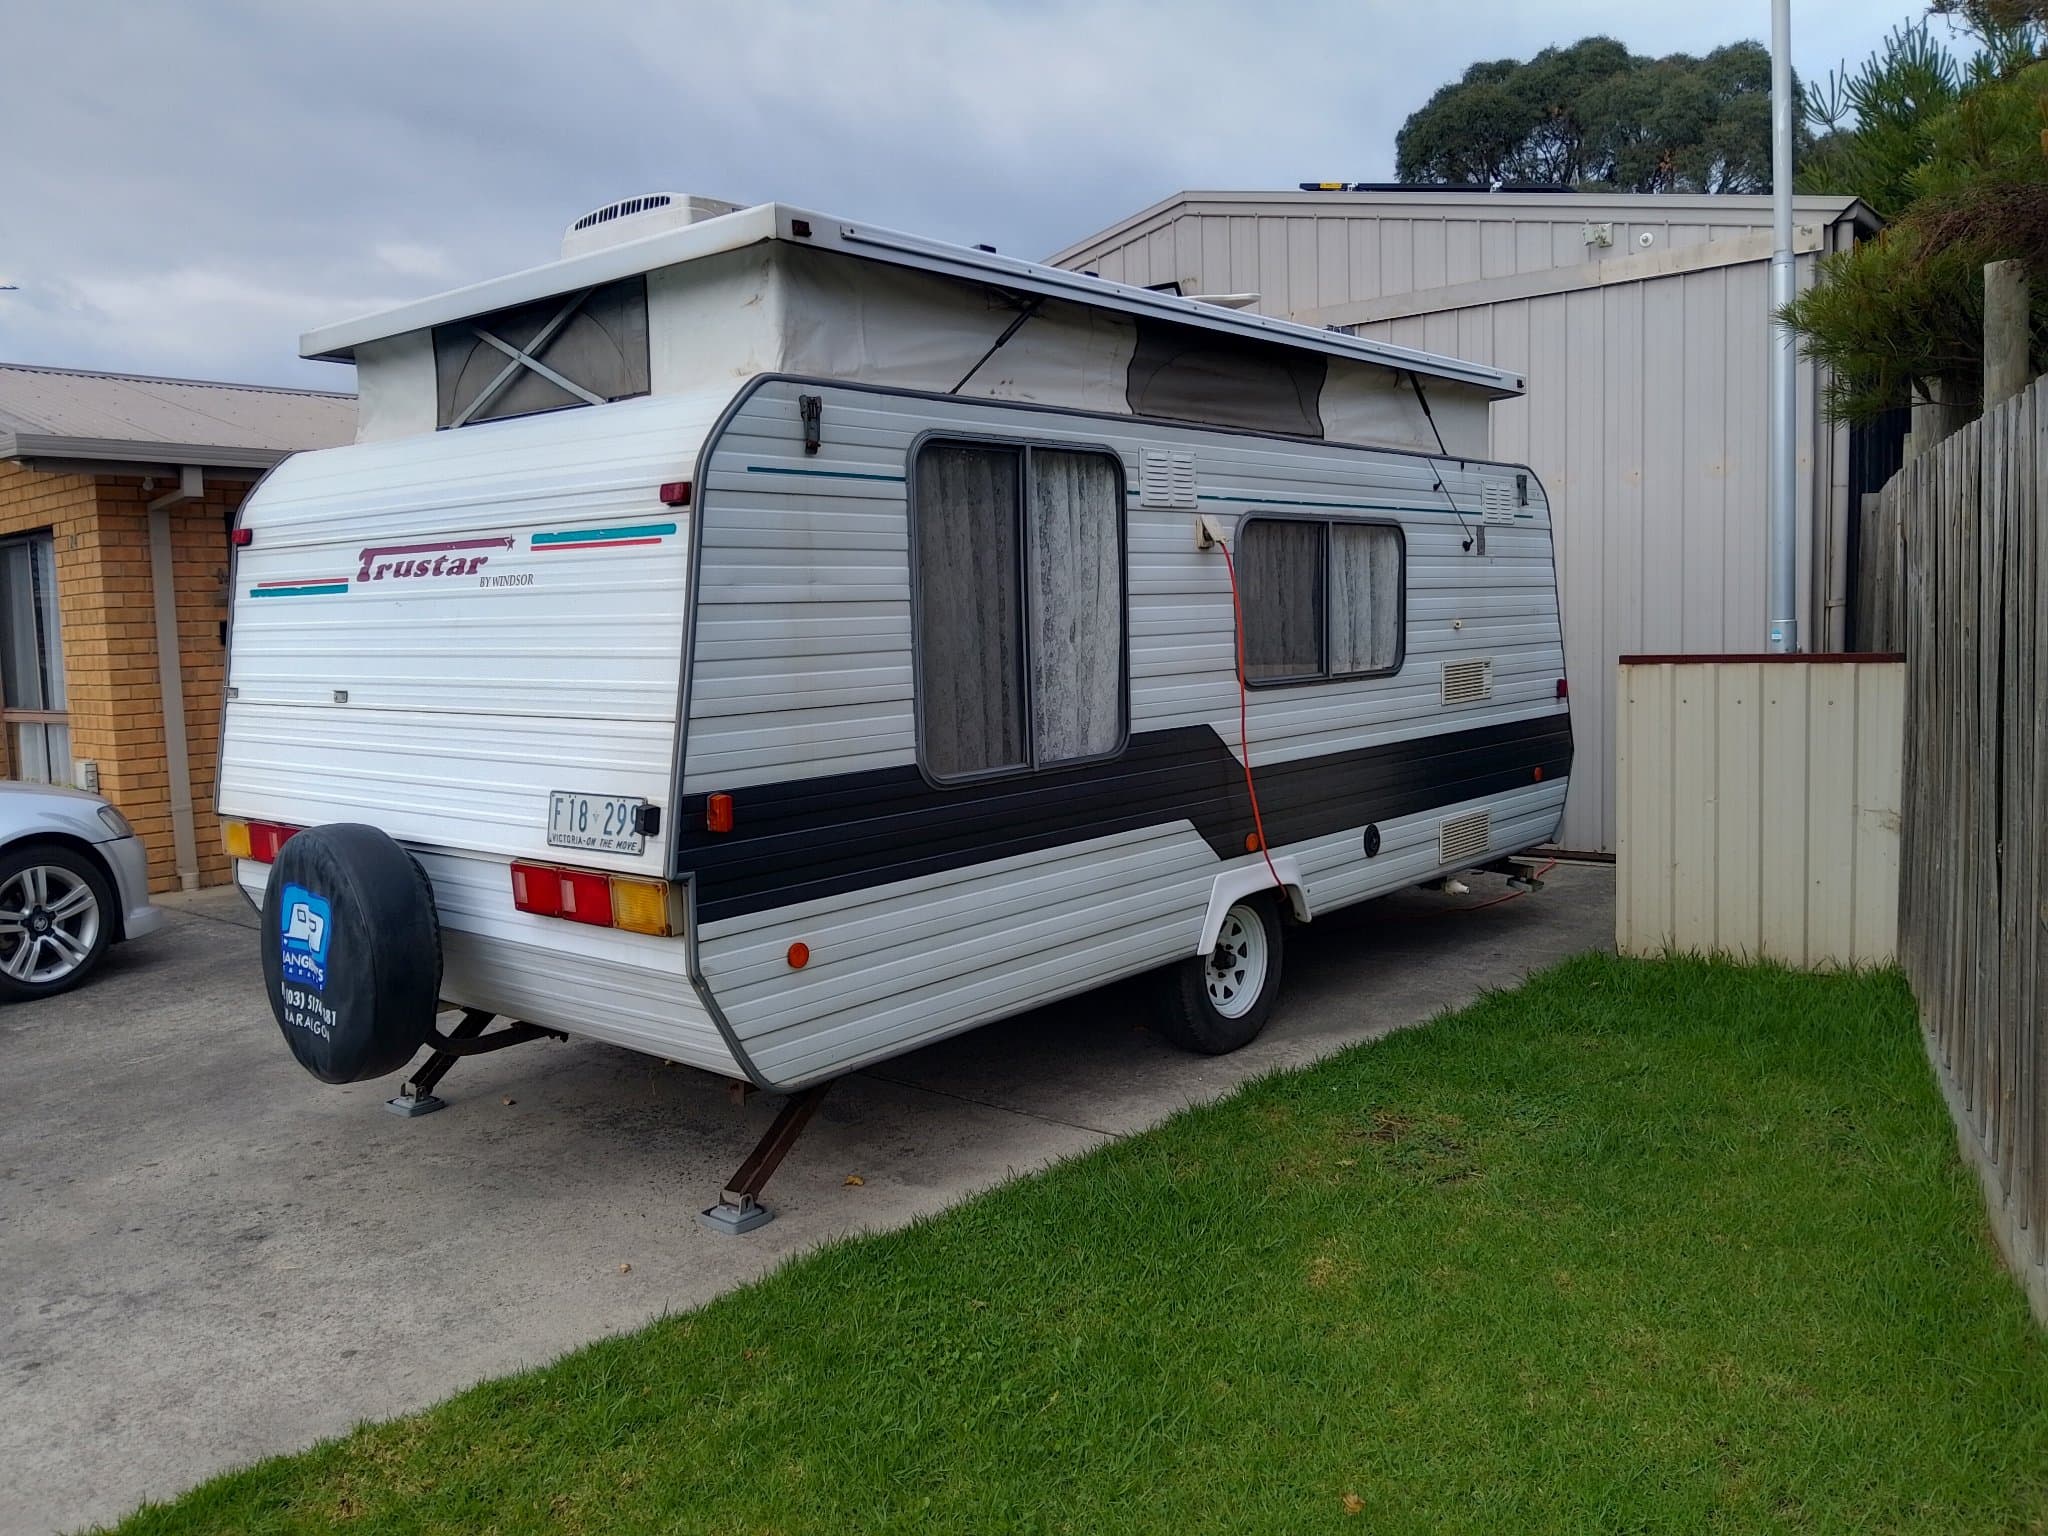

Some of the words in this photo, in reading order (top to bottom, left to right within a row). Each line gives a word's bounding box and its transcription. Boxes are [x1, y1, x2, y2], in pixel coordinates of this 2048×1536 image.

[356, 537, 509, 582] Trustar
[479, 576, 491, 588] BY
[492, 573, 534, 587] WINDSOR
[553, 797, 588, 833] F18
[600, 838, 614, 849] THE
[616, 840, 638, 850] MOVE
